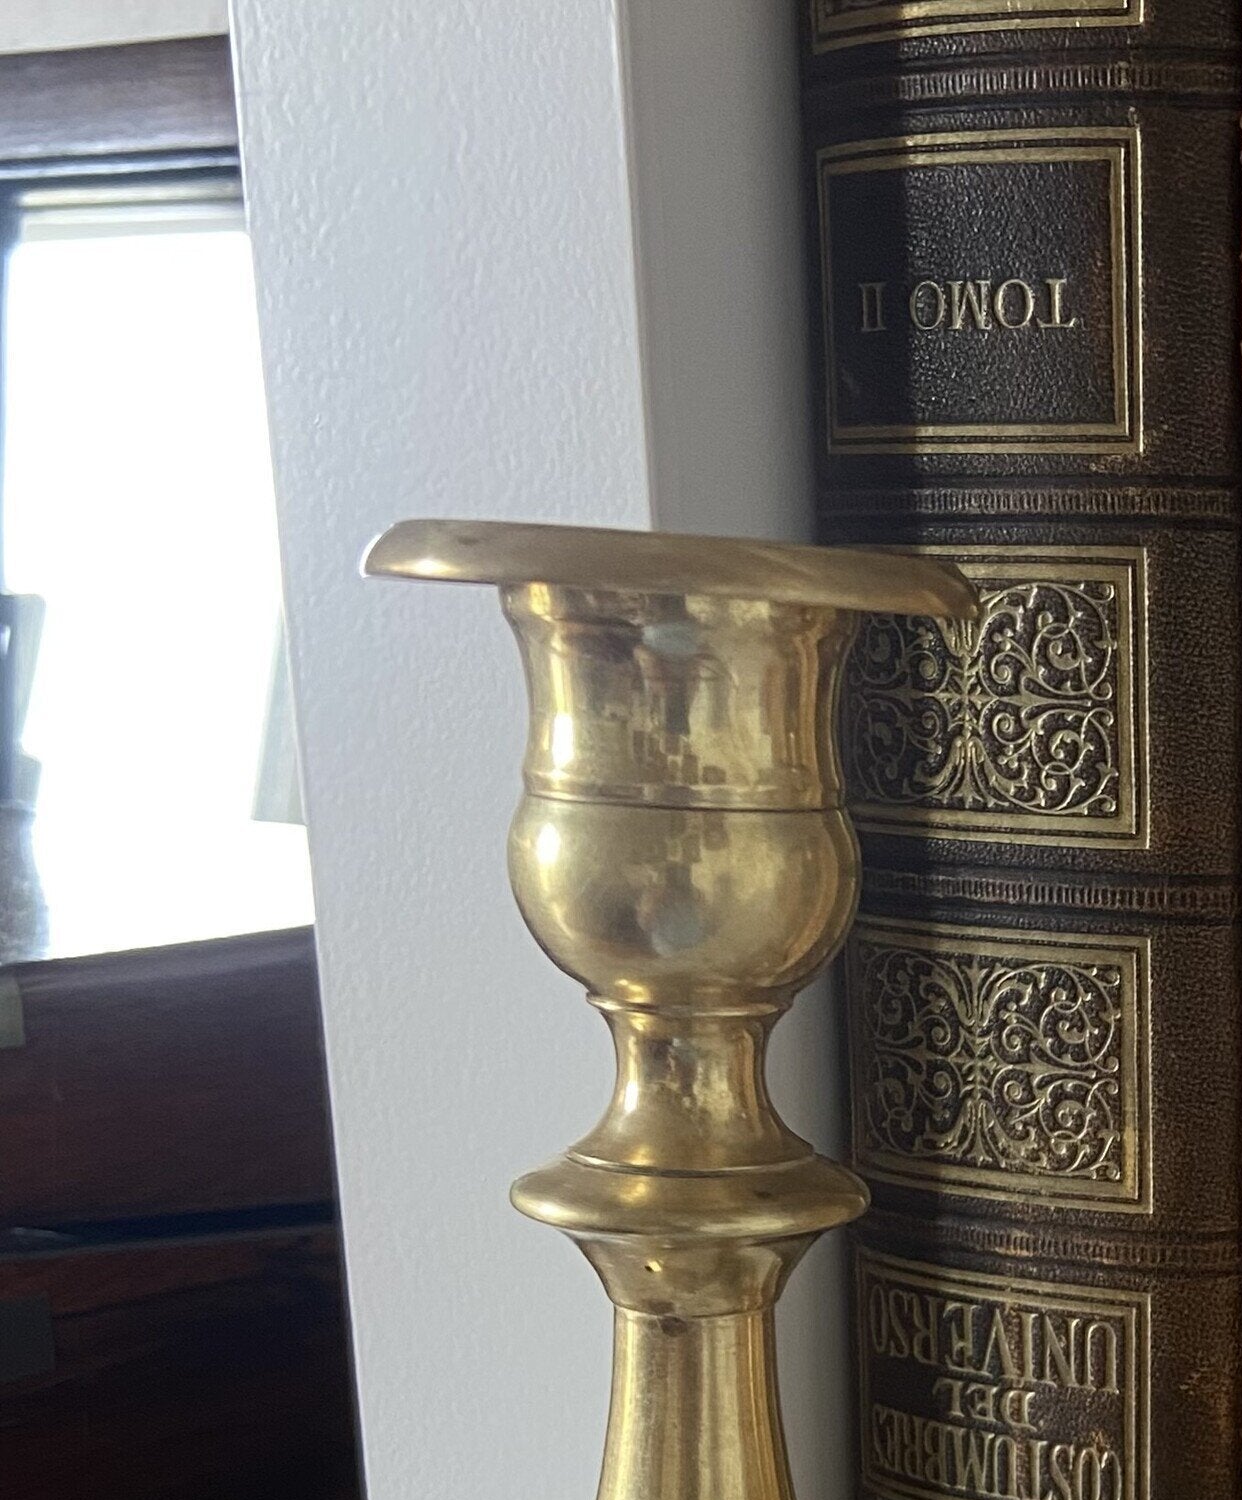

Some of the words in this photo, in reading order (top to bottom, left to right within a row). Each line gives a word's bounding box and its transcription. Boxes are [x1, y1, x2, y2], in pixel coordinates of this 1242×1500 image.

[858, 281, 888, 333] II
[909, 277, 1077, 331] TOMO
[870, 1283, 1120, 1395] UNIVERSO
[932, 1377, 1038, 1432] DEL
